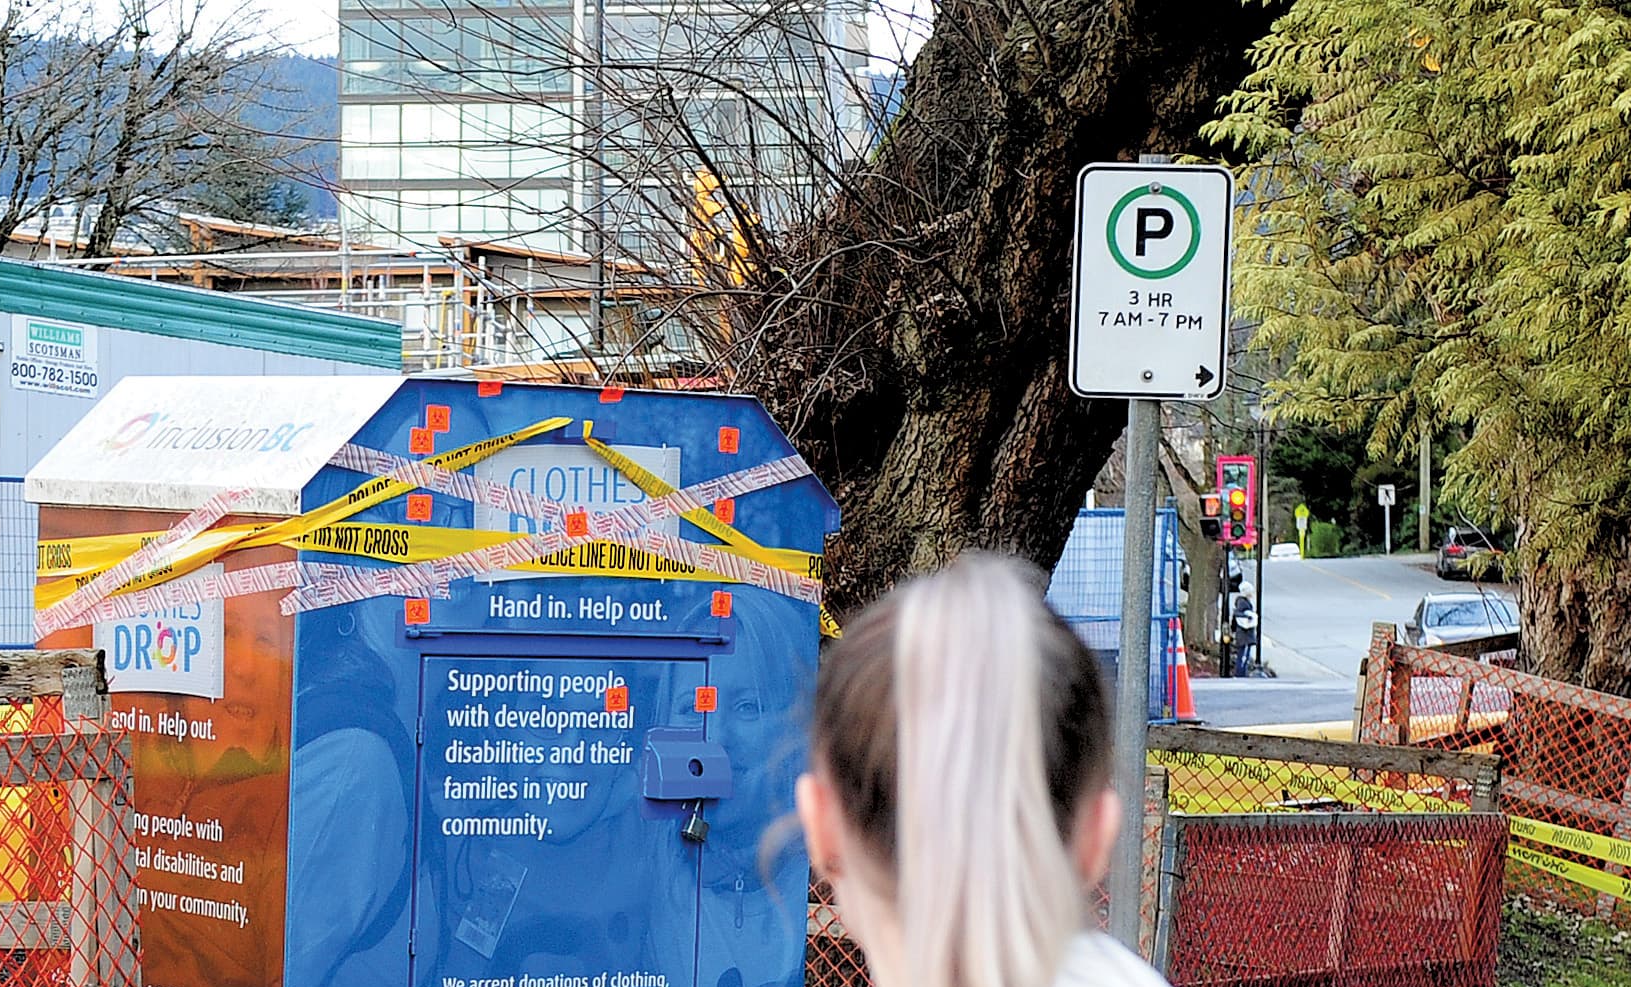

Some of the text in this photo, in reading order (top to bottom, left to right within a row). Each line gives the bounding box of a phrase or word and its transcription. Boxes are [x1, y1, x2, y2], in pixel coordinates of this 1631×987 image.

[1135, 207, 1174, 257] P
[1129, 290, 1173, 308] 3 HR
[30, 325, 82, 344] WILLIAMS
[1098, 312, 1109, 327] 7
[1114, 312, 1142, 327] AM
[1158, 313, 1169, 327] 7
[1176, 315, 1203, 330] PM
[29, 342, 81, 360] SCOTSMAN
[11, 362, 98, 387] 800-782-1500
[363, 527, 409, 556] CROSS
[579, 542, 606, 569] LINE
[609, 543, 625, 570] DO
[490, 594, 669, 626] Hand in. Help out.
[114, 621, 202, 673] DROP
[447, 669, 626, 699] Supporting people
[138, 709, 155, 733] in.
[158, 712, 187, 742] Help
[190, 718, 217, 740] out.
[447, 704, 635, 734] with developmental
[445, 739, 634, 764] disabilities and their
[444, 776, 588, 805] families in your
[152, 814, 193, 841] people
[195, 818, 223, 843] with
[442, 813, 553, 841] community.
[135, 846, 244, 884] tal disabilities and
[151, 888, 178, 912] your
[179, 894, 249, 929] community.
